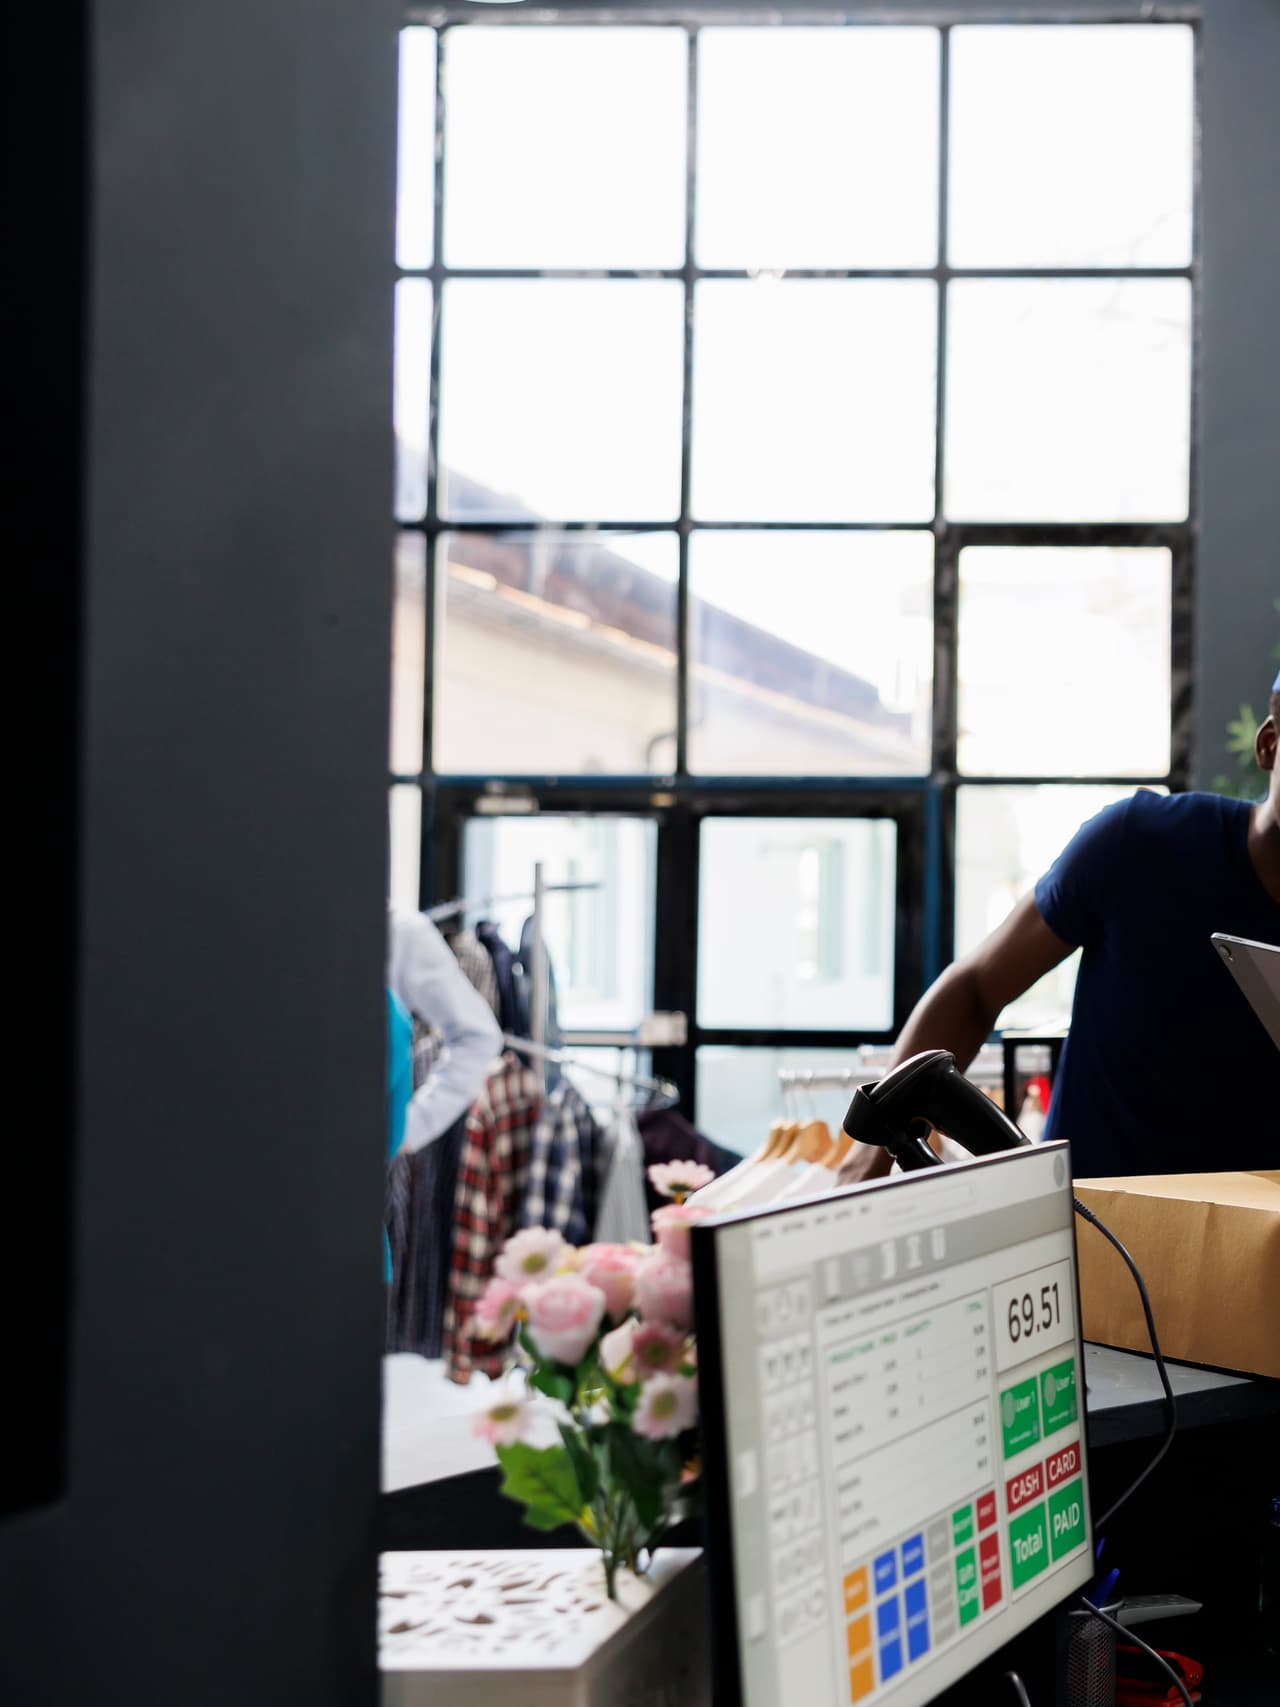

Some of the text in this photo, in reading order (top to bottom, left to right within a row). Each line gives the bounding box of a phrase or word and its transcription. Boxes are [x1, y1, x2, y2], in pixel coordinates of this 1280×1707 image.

[1008, 1282, 1060, 1343] 69.51
[1049, 1450, 1077, 1481] CARD
[1011, 1471, 1040, 1504] CASH
[1053, 1502, 1080, 1538] PAID
[1013, 1525, 1043, 1565] Total
